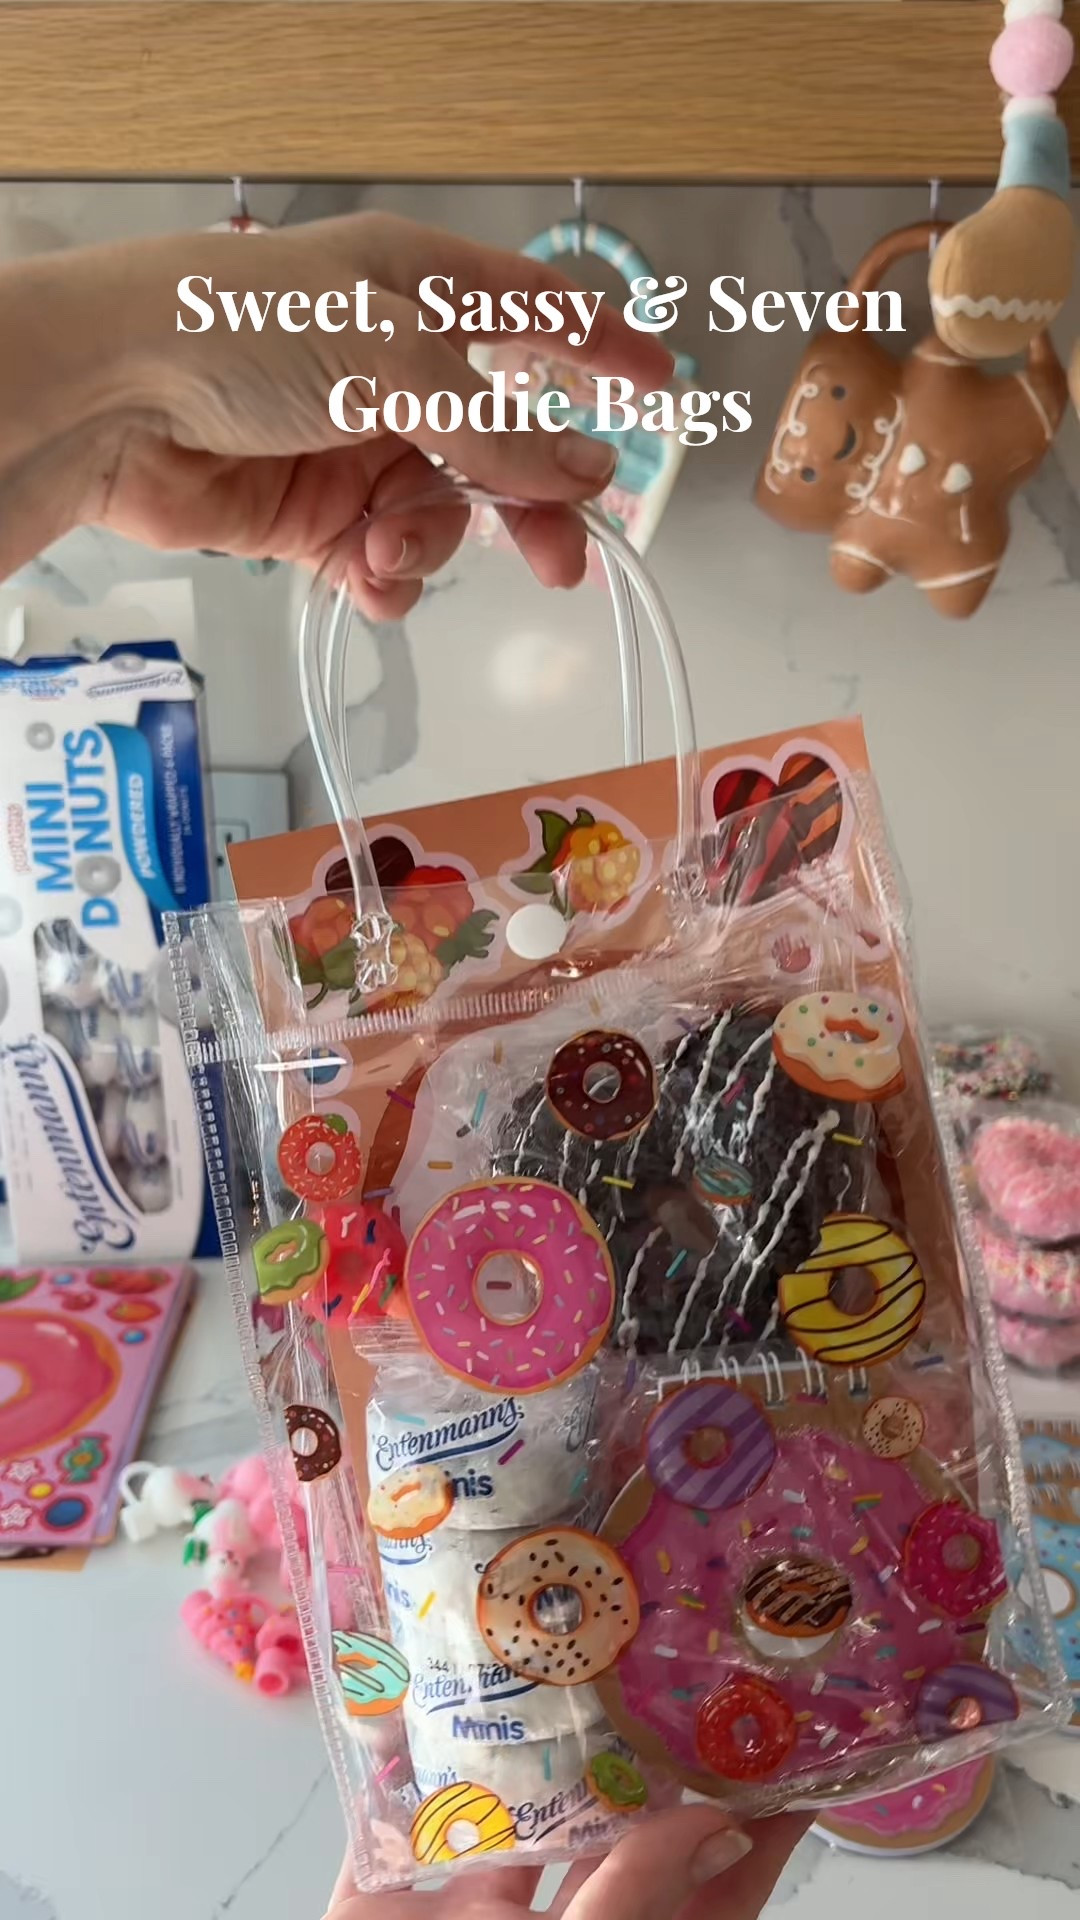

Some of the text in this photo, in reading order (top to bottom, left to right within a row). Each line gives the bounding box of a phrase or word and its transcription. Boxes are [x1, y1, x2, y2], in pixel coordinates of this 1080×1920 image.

[25, 782, 75, 893] MINI
[63, 728, 121, 929] DONUTS
[128, 773, 156, 878] POWDERED
[4, 1033, 136, 1254] Entenmann's
[372, 1396, 526, 1471] Entenmann's
[444, 1468, 493, 1498] nis
[452, 1714, 525, 1742] Minis
